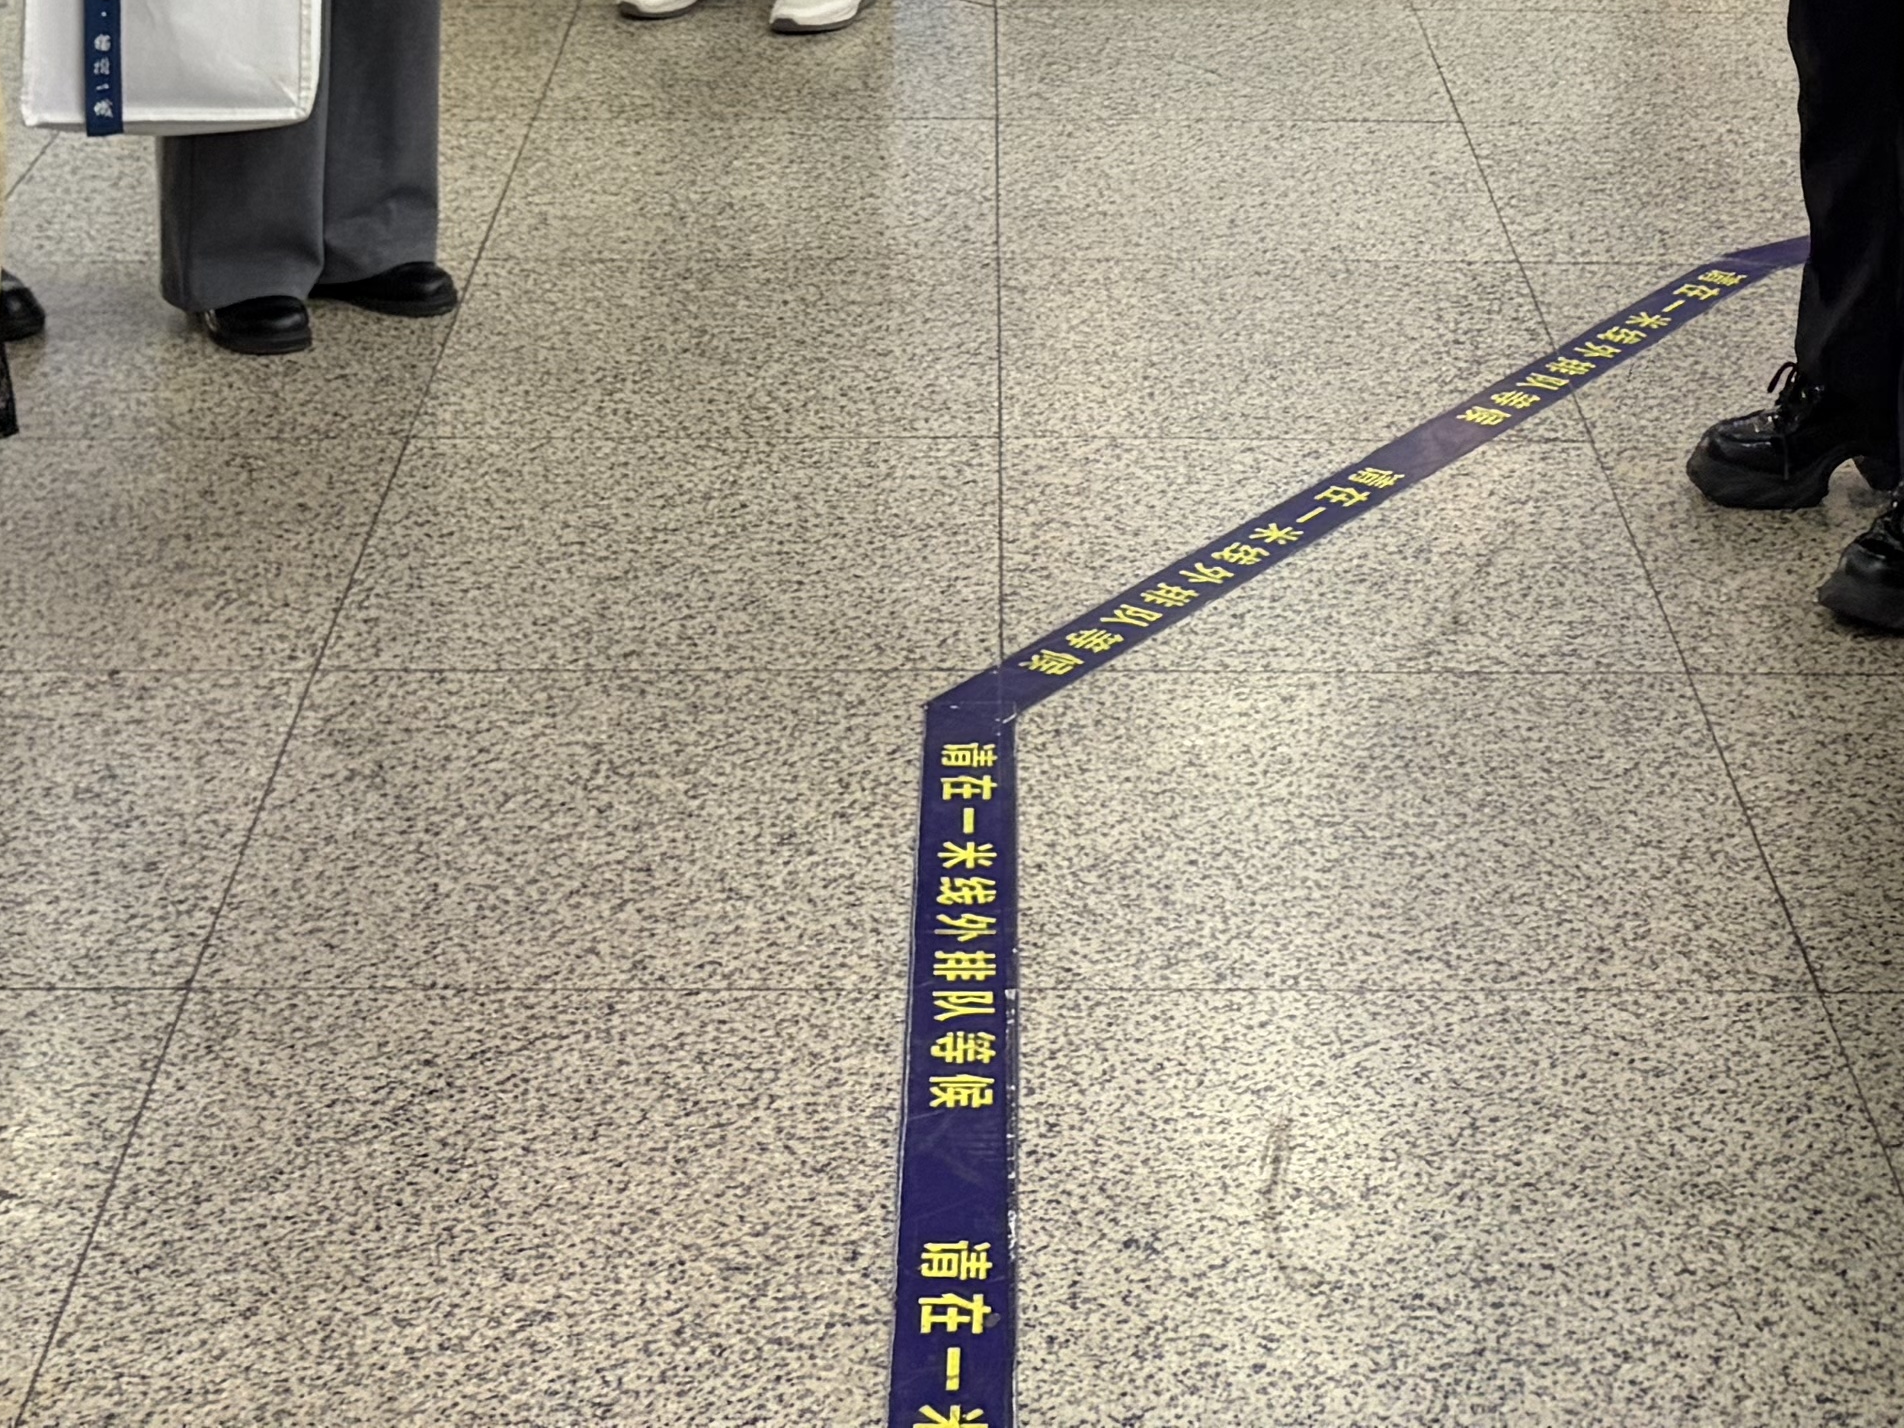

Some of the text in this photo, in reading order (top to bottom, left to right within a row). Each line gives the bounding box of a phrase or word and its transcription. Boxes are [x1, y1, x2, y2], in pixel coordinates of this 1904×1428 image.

[1455, 268, 1749, 429] 请在一米线外排队等候
[1018, 465, 1407, 677] 请在一米线外排队等候
[929, 742, 998, 1108] 请在一米线外排队等候
